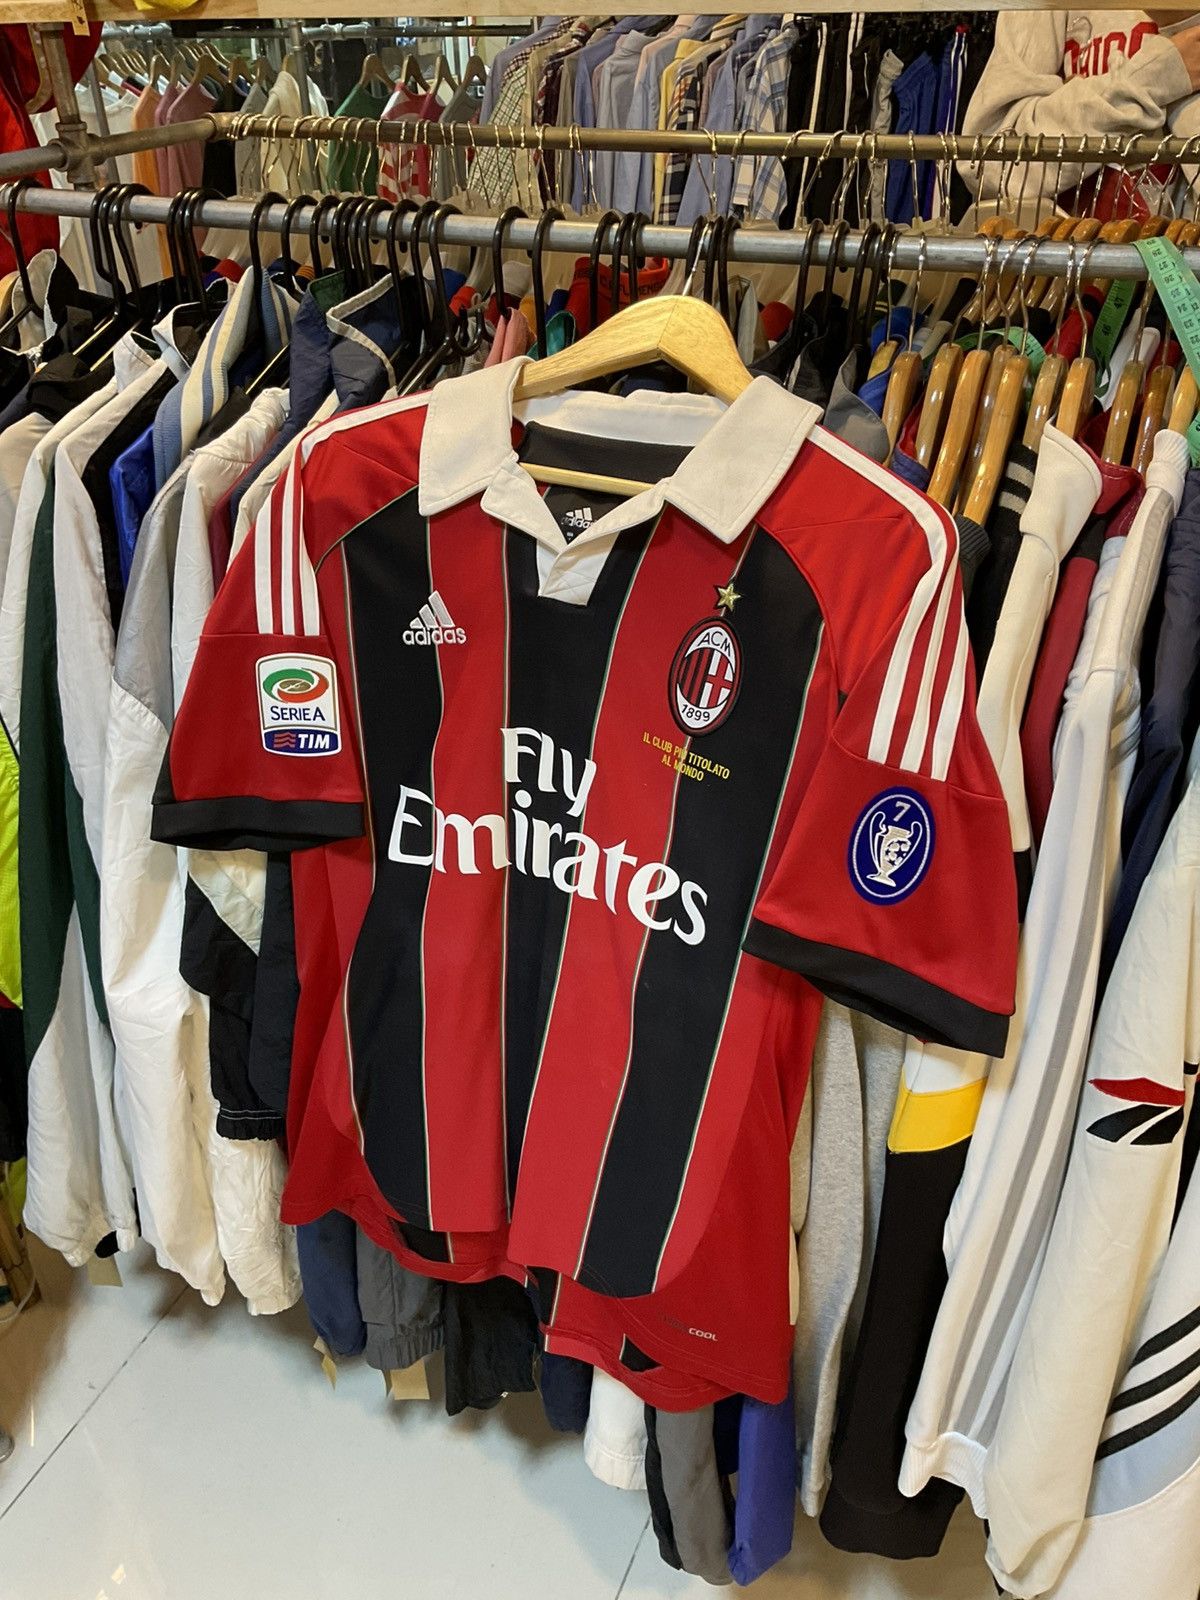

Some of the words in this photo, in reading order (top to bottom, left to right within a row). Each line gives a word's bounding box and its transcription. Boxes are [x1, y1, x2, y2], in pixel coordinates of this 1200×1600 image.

[402, 626, 467, 646] adidas
[697, 631, 731, 657] ACM
[270, 705, 311, 721] SERIE
[313, 706, 326, 721] A
[681, 704, 711, 722] 1899
[298, 733, 330, 749] TIM
[643, 731, 651, 744] IL
[652, 736, 673, 753] CLUB
[688, 752, 731, 780] TITOLATO
[500, 727, 597, 818] Fly
[661, 754, 672, 767] AL
[673, 759, 705, 782] MONDO
[893, 801, 911, 822] 7
[387, 784, 709, 946] Emirates
[688, 1327, 719, 1342] COOL
